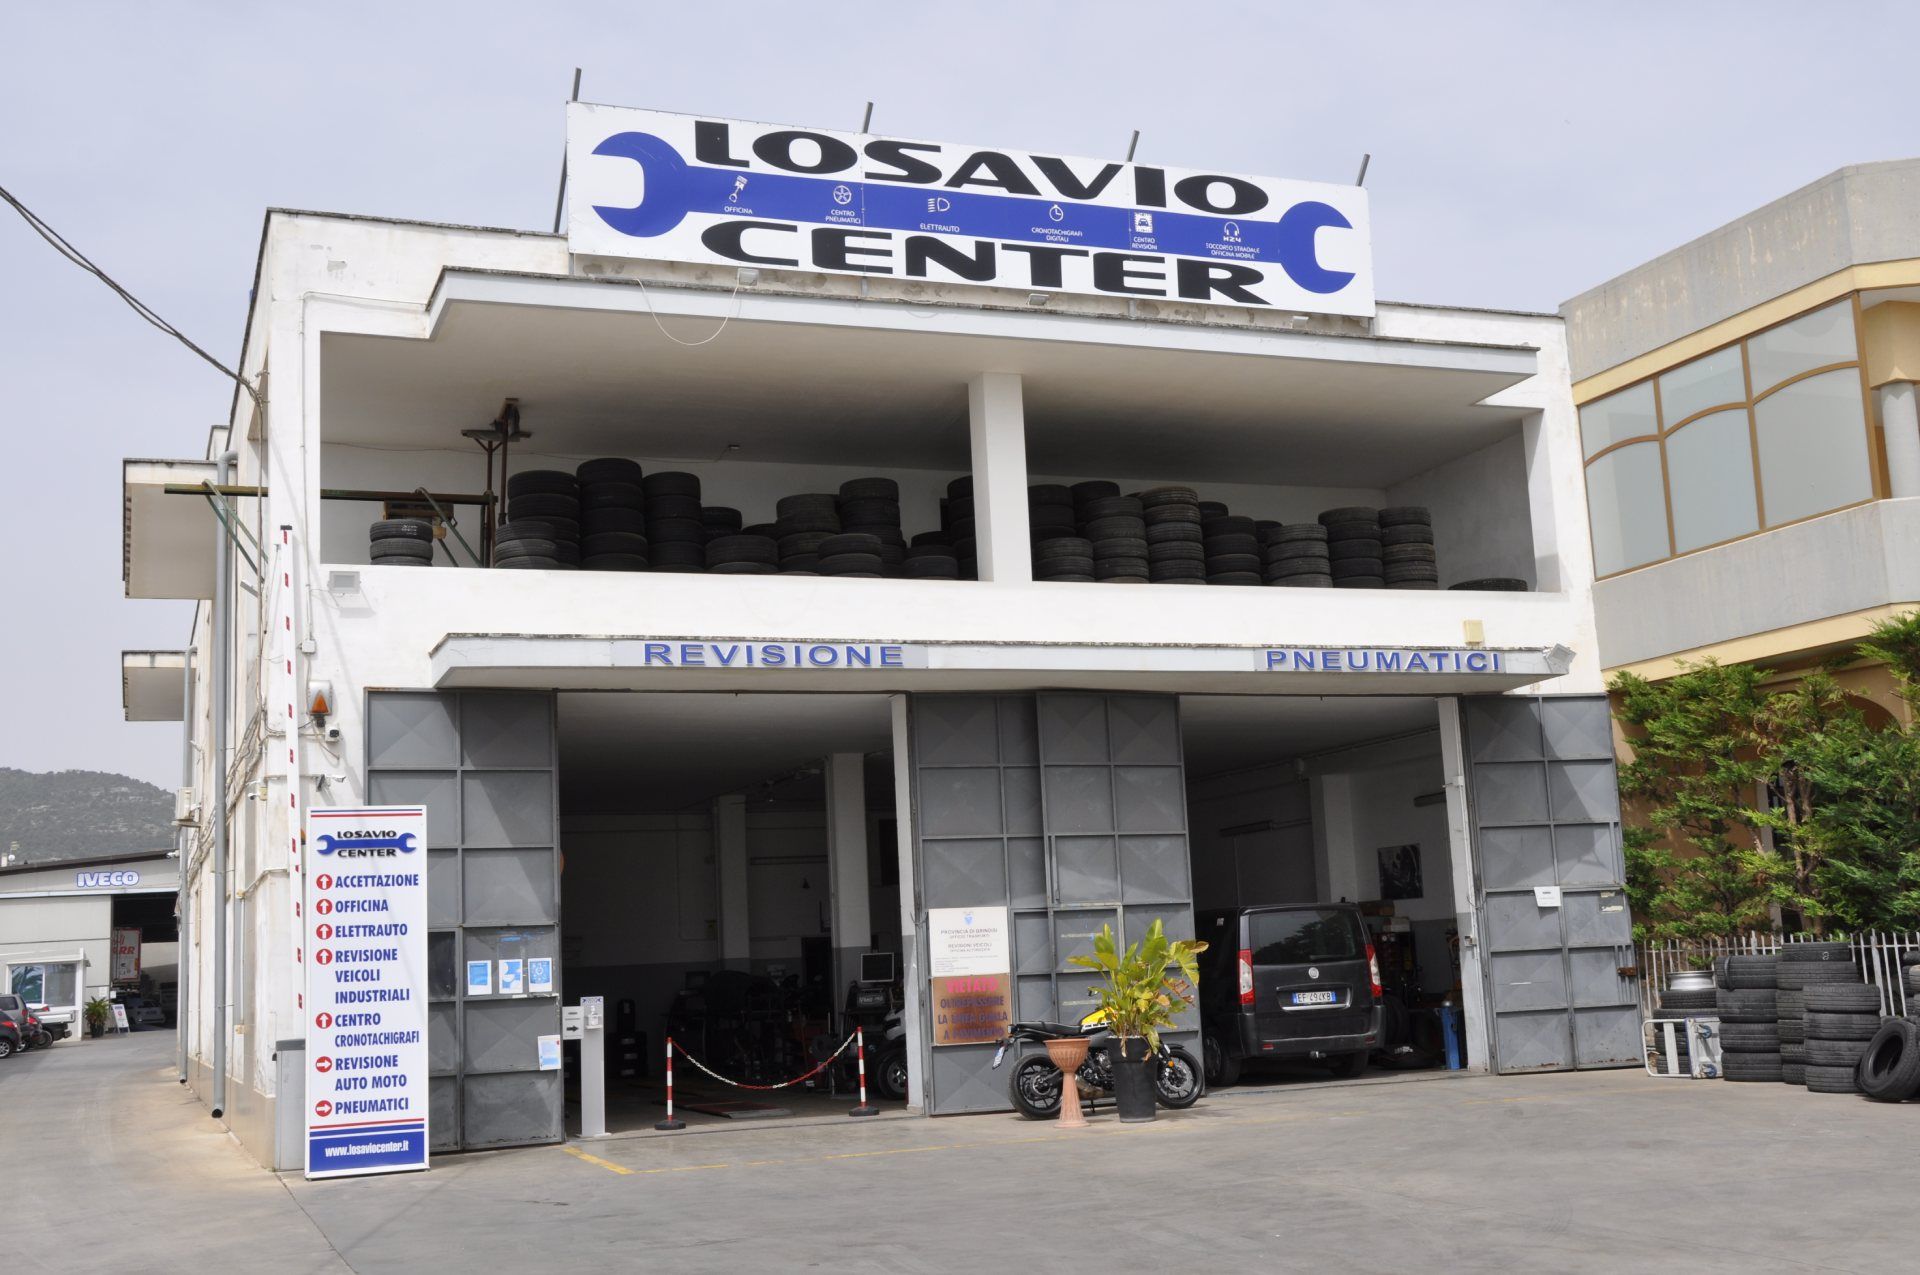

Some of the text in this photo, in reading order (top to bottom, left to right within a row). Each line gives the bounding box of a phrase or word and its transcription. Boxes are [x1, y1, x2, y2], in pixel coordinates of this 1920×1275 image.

[695, 120, 1269, 215] LOSAVIO
[724, 206, 753, 214] OFFICINA
[830, 209, 855, 217] CENTRO
[825, 216, 861, 224] PNEUMATICI
[920, 223, 960, 233] ELETTRAUTO
[1031, 227, 1083, 238] CRONOTACHIGRAFI
[1046, 235, 1069, 243] DIGITALI
[1131, 242, 1158, 250] REVISIONI
[1133, 236, 1156, 244] CENTRO
[1223, 235, 1242, 243] H24
[1205, 243, 1260, 254] SOCCORSO STRADALE
[1211, 249, 1255, 260] OFFICINA MOBILE
[701, 220, 1273, 305] CENTER
[643, 643, 904, 666] REVISIONE
[1266, 650, 1499, 672] PNEUMATICI
[337, 830, 397, 839] LOSAVIO
[337, 848, 397, 858] CENTER
[76, 871, 139, 887] IVECO
[335, 874, 419, 888] ACCETTAZIONE
[335, 899, 389, 913] OFFICINA
[335, 923, 408, 938] ELETTRAUTO
[335, 949, 398, 963] REVISIONE
[335, 969, 380, 983] VEICOLI
[335, 988, 410, 1004] INDUSTRIALI
[335, 1012, 381, 1028] CENTRO
[335, 1030, 420, 1048] CRONOTACHIGRAFI
[335, 1055, 398, 1071] REVISIONE
[335, 1074, 407, 1091] AUTO MOTO
[335, 1097, 409, 1115] PNEUMATICI
[324, 1140, 409, 1157] www.losaviocenter.it
